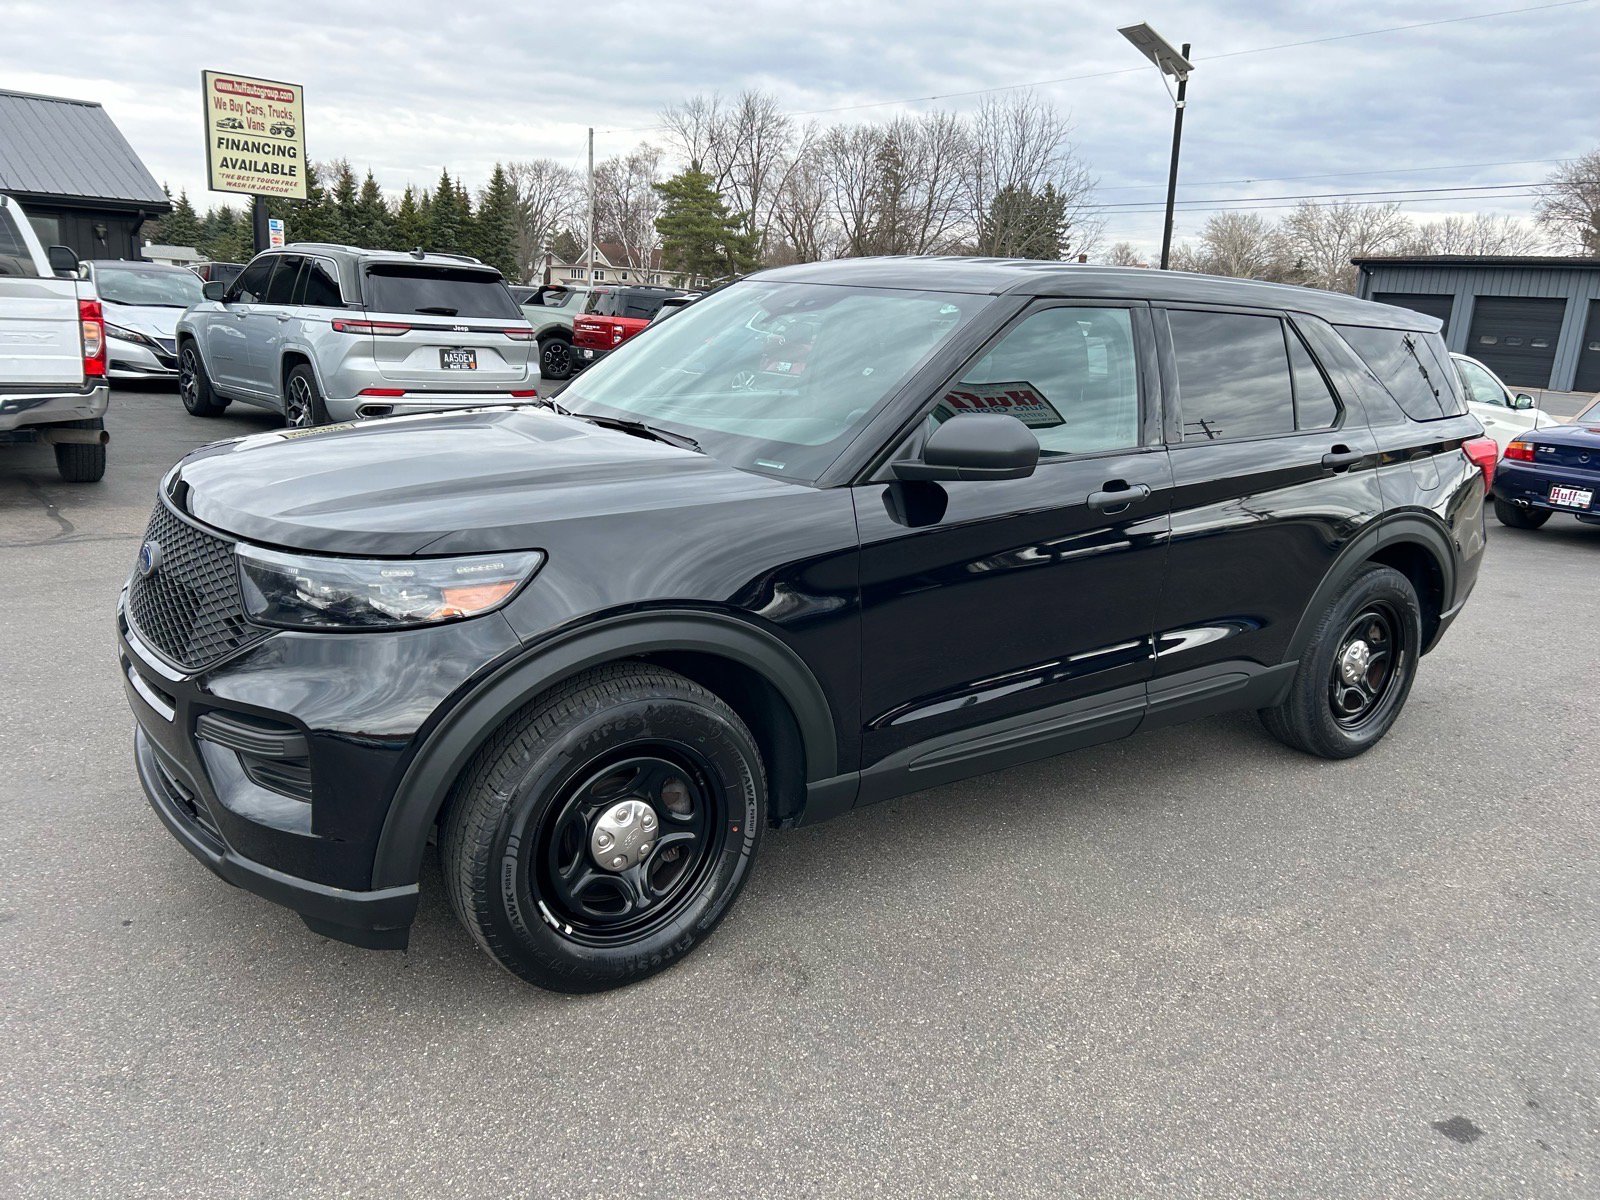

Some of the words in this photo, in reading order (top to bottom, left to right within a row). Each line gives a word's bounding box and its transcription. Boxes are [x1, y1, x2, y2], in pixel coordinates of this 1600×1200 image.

[213, 96, 227, 110] We
[229, 98, 244, 116] Buy
[245, 101, 266, 118] Cars,
[267, 104, 295, 122] Trucks,
[246, 116, 265, 131] Vans
[217, 136, 297, 158] FINANCING
[219, 156, 297, 177] AVAILABLE
[236, 174, 255, 182] BEST
[256, 177, 281, 185] TOUCH
[1551, 488, 1578, 501] Huff
